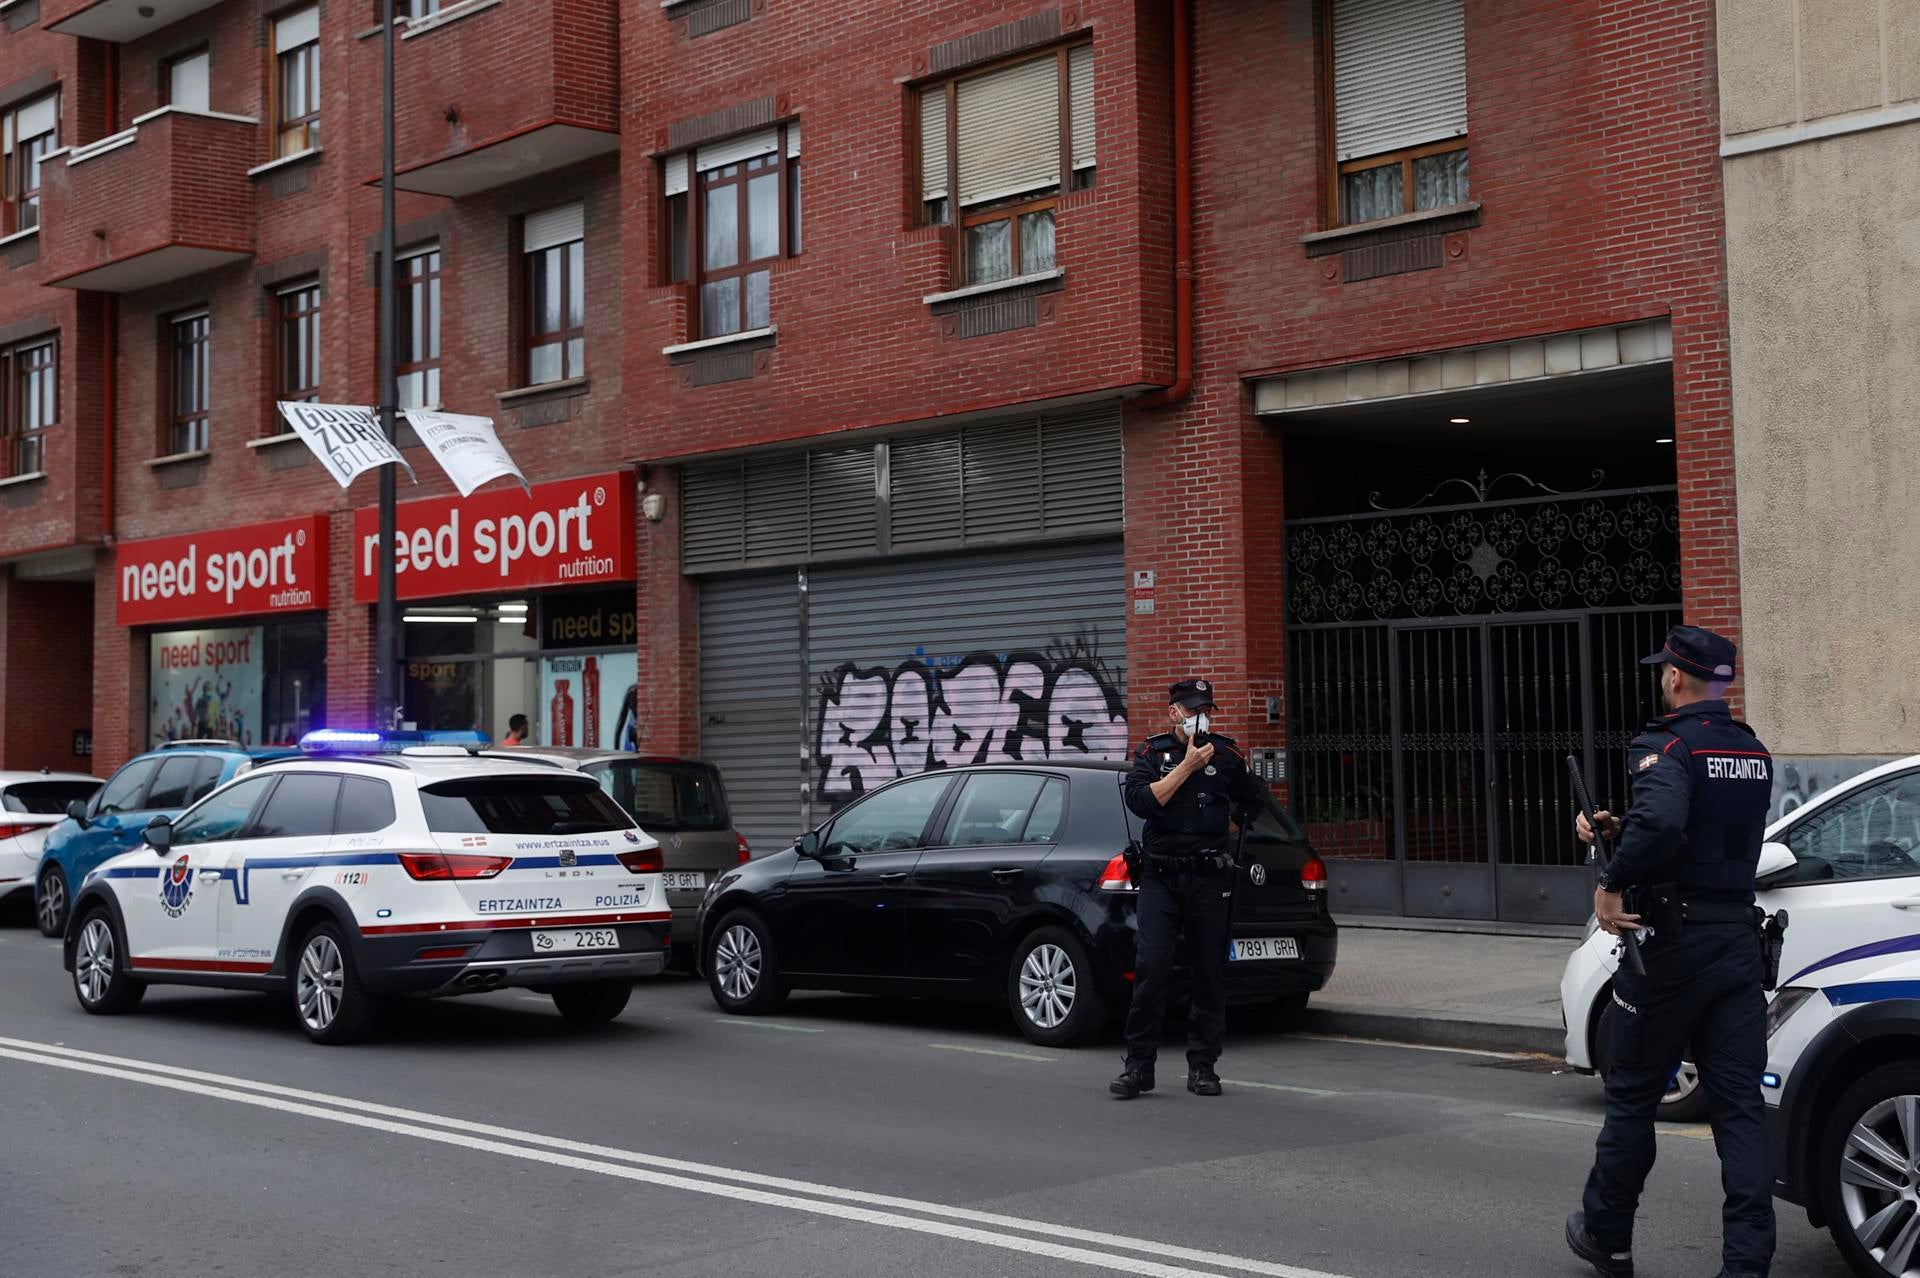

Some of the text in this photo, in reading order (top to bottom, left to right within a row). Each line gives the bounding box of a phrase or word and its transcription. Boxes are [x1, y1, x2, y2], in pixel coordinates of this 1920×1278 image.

[313, 423, 387, 455] ZURI
[364, 491, 593, 577] need sport
[123, 533, 296, 604] need sport
[559, 556, 613, 579] nutrition
[270, 589, 311, 607] nutrition
[552, 607, 635, 643] need sp
[161, 631, 251, 673] need sport
[408, 662, 457, 680] sport
[1707, 757, 1769, 780] ERTZAINTZA
[515, 838, 611, 850] www.ertzaintza.eus
[343, 872, 361, 884] 112
[545, 870, 594, 878] LEON
[679, 873, 699, 887] GRT
[479, 894, 641, 912] ERTZAINTZA POLIZIA
[575, 931, 617, 947] 2262
[1238, 940, 1295, 957] 7891 GRH
